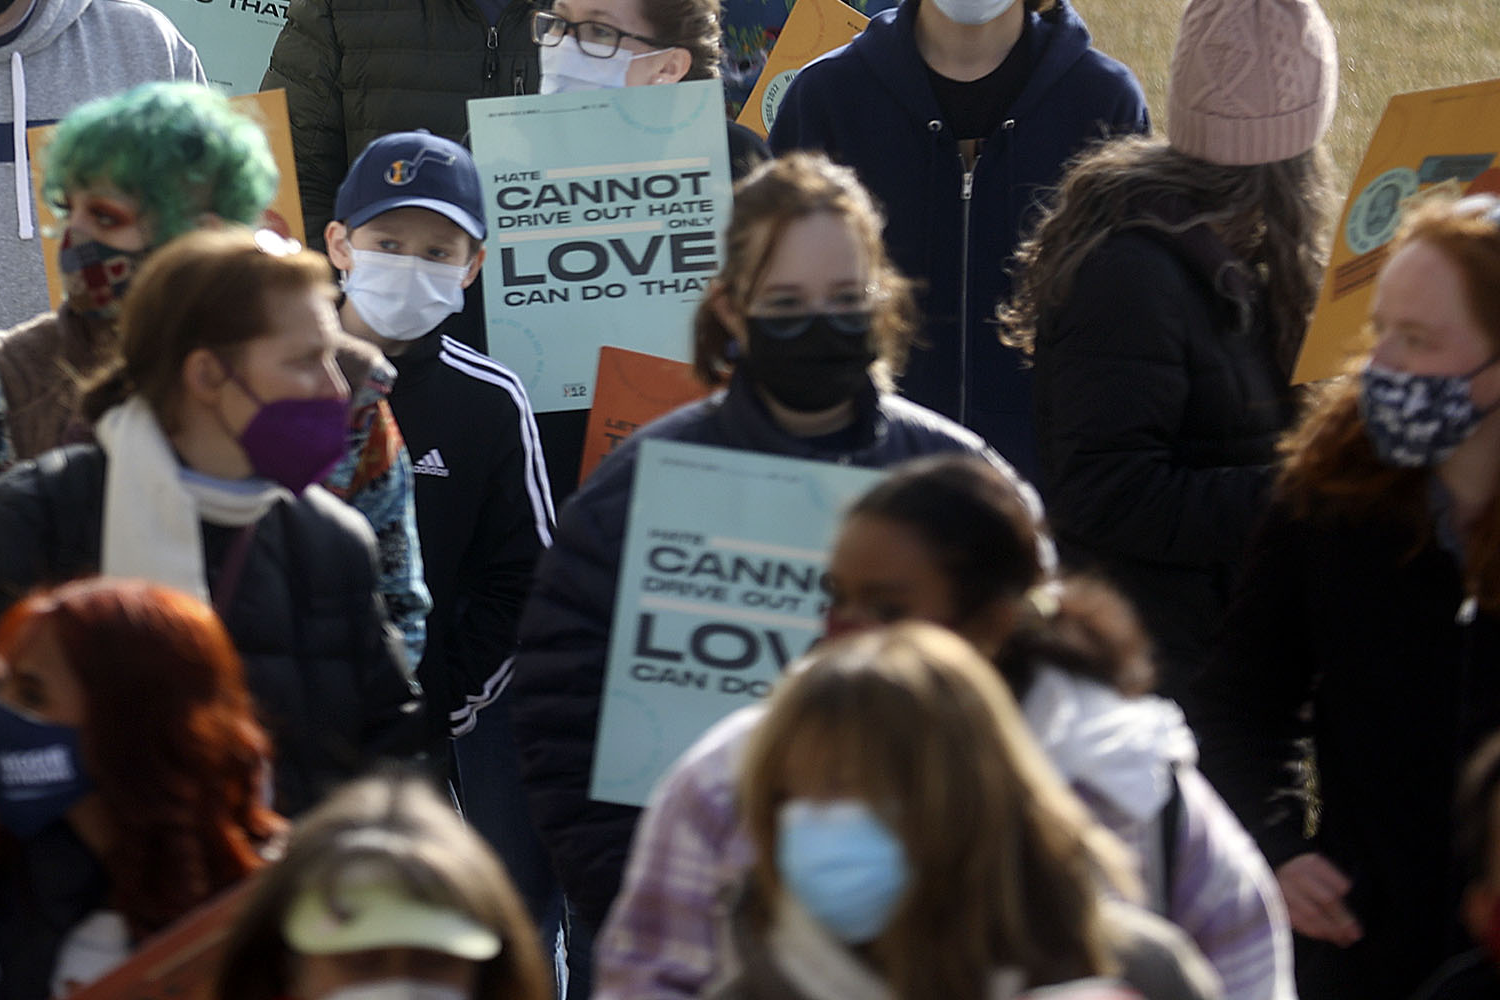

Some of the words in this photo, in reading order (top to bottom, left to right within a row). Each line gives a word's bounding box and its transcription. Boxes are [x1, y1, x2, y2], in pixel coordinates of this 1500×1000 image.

[494, 171, 541, 183] HATE
[497, 171, 710, 211] CANNOT
[498, 211, 572, 229] DRIVE
[584, 206, 636, 221] OUT
[648, 200, 713, 215] HATE
[668, 217, 713, 228] ONLY
[501, 231, 718, 287] LOVE
[504, 288, 569, 306] CAN
[582, 283, 627, 300] DO
[413, 465, 450, 477] adidas
[646, 546, 834, 594] CANN
[642, 576, 727, 602] DRIVE
[740, 590, 803, 612] OUT
[630, 664, 707, 690] CAN
